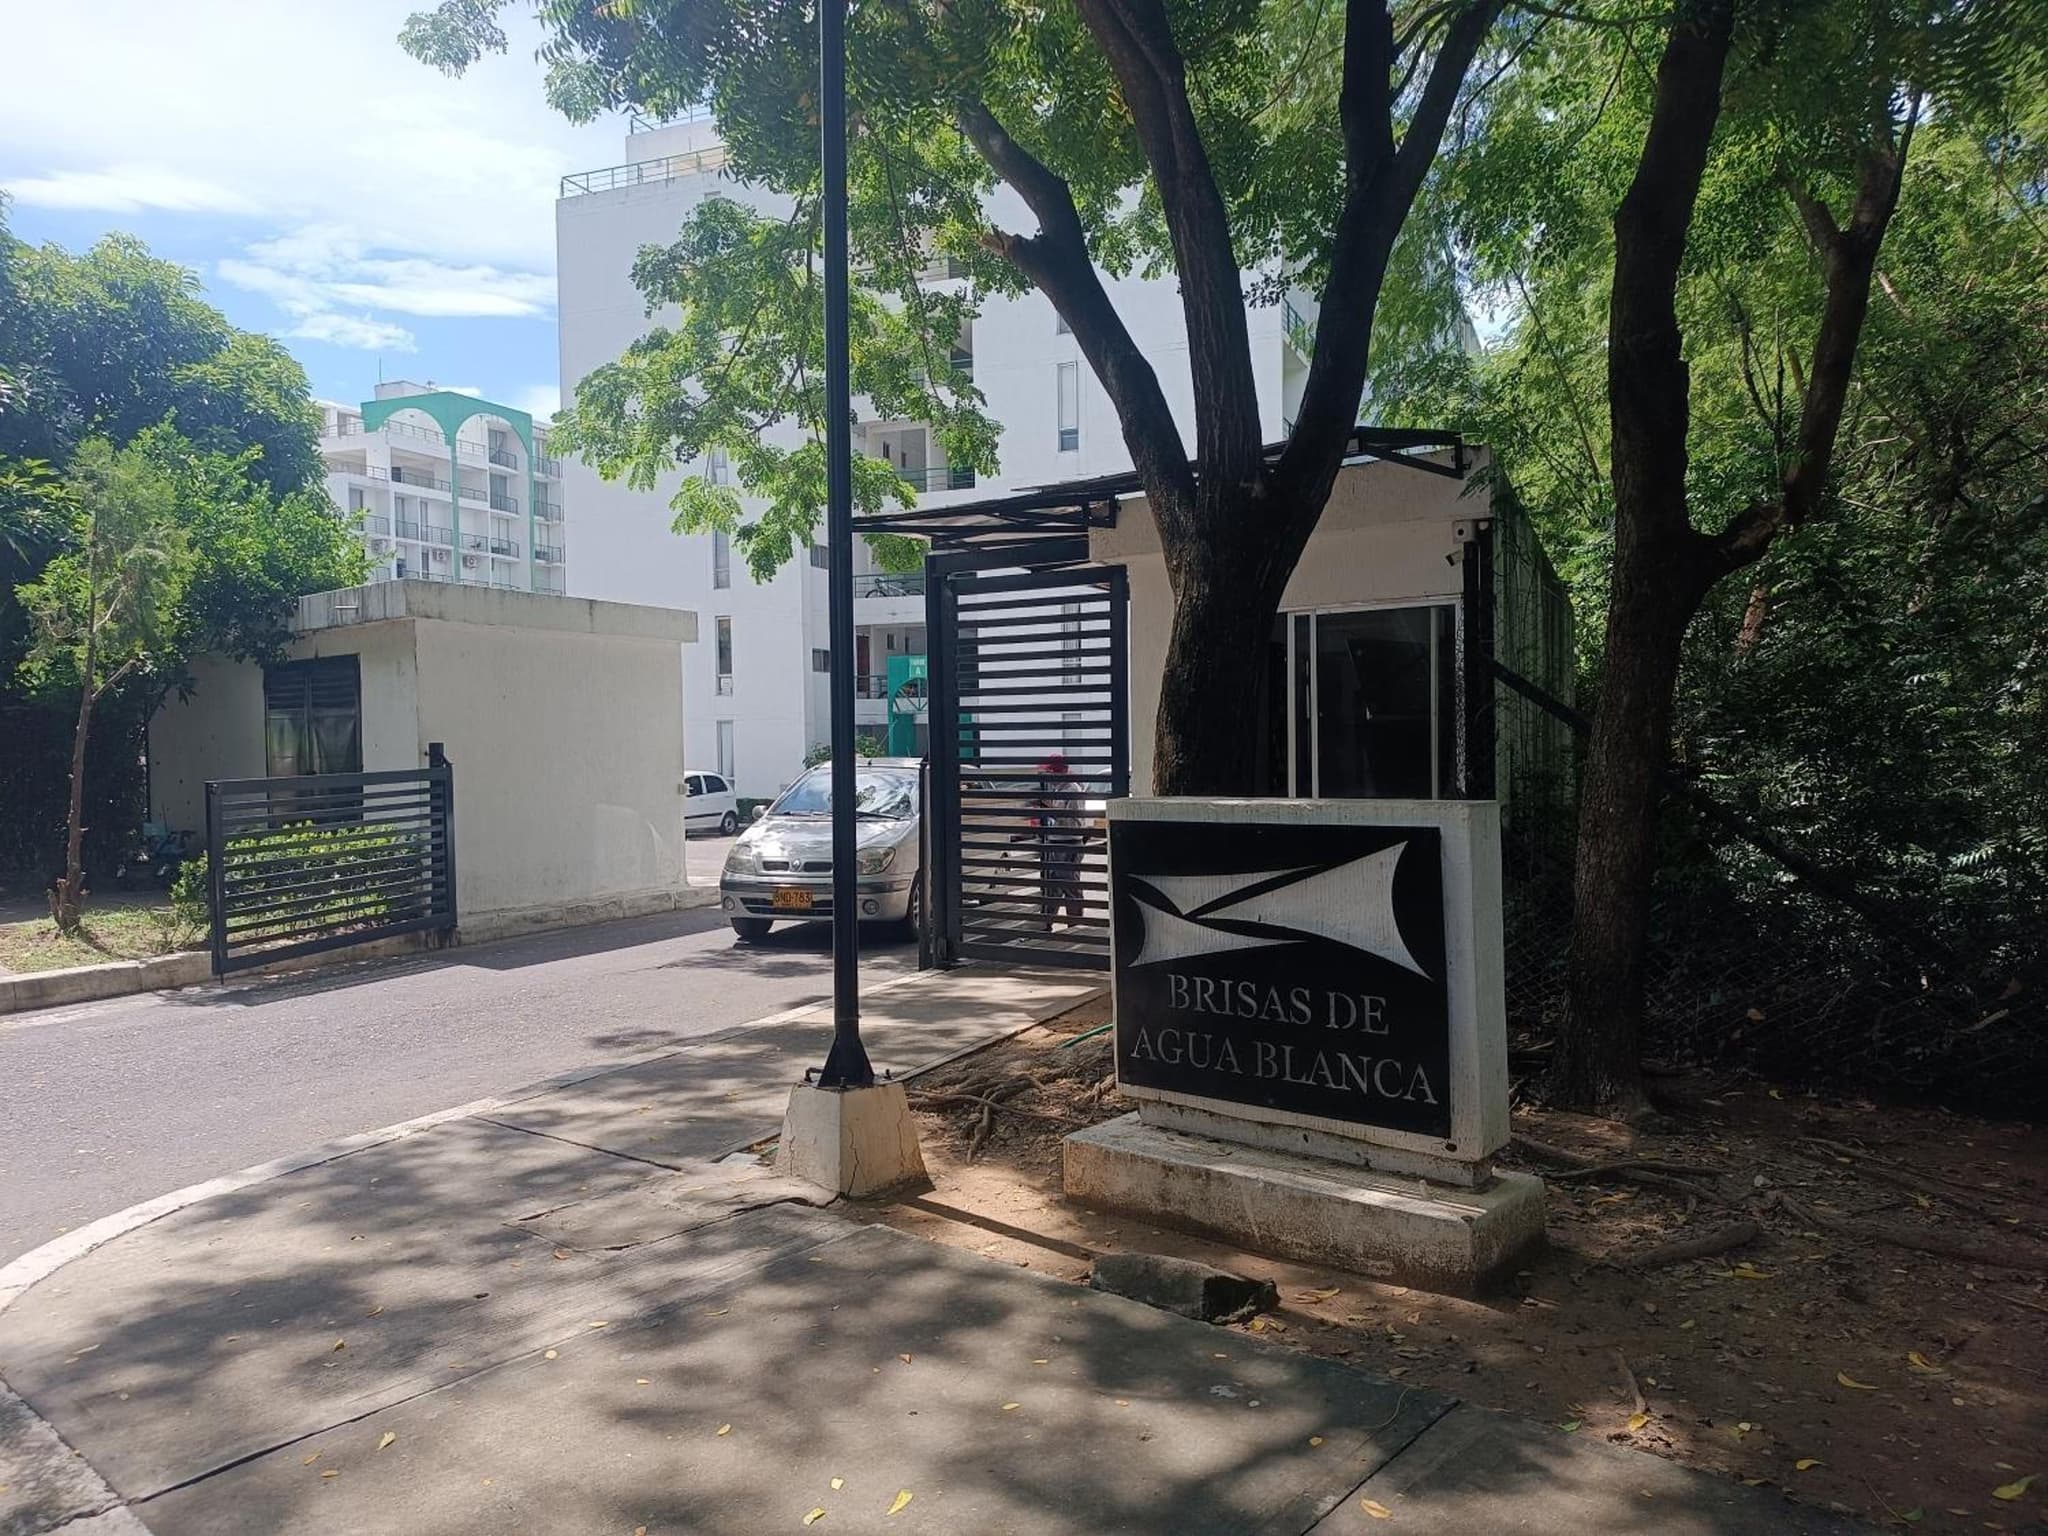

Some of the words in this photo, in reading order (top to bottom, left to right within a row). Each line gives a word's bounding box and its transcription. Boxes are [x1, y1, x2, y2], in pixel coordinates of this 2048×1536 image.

[1167, 974, 1312, 1025] BRISAS
[1326, 991, 1390, 1035] DE
[1130, 1024, 1244, 1074] AGUA
[1255, 1041, 1438, 1104] BLANCA
